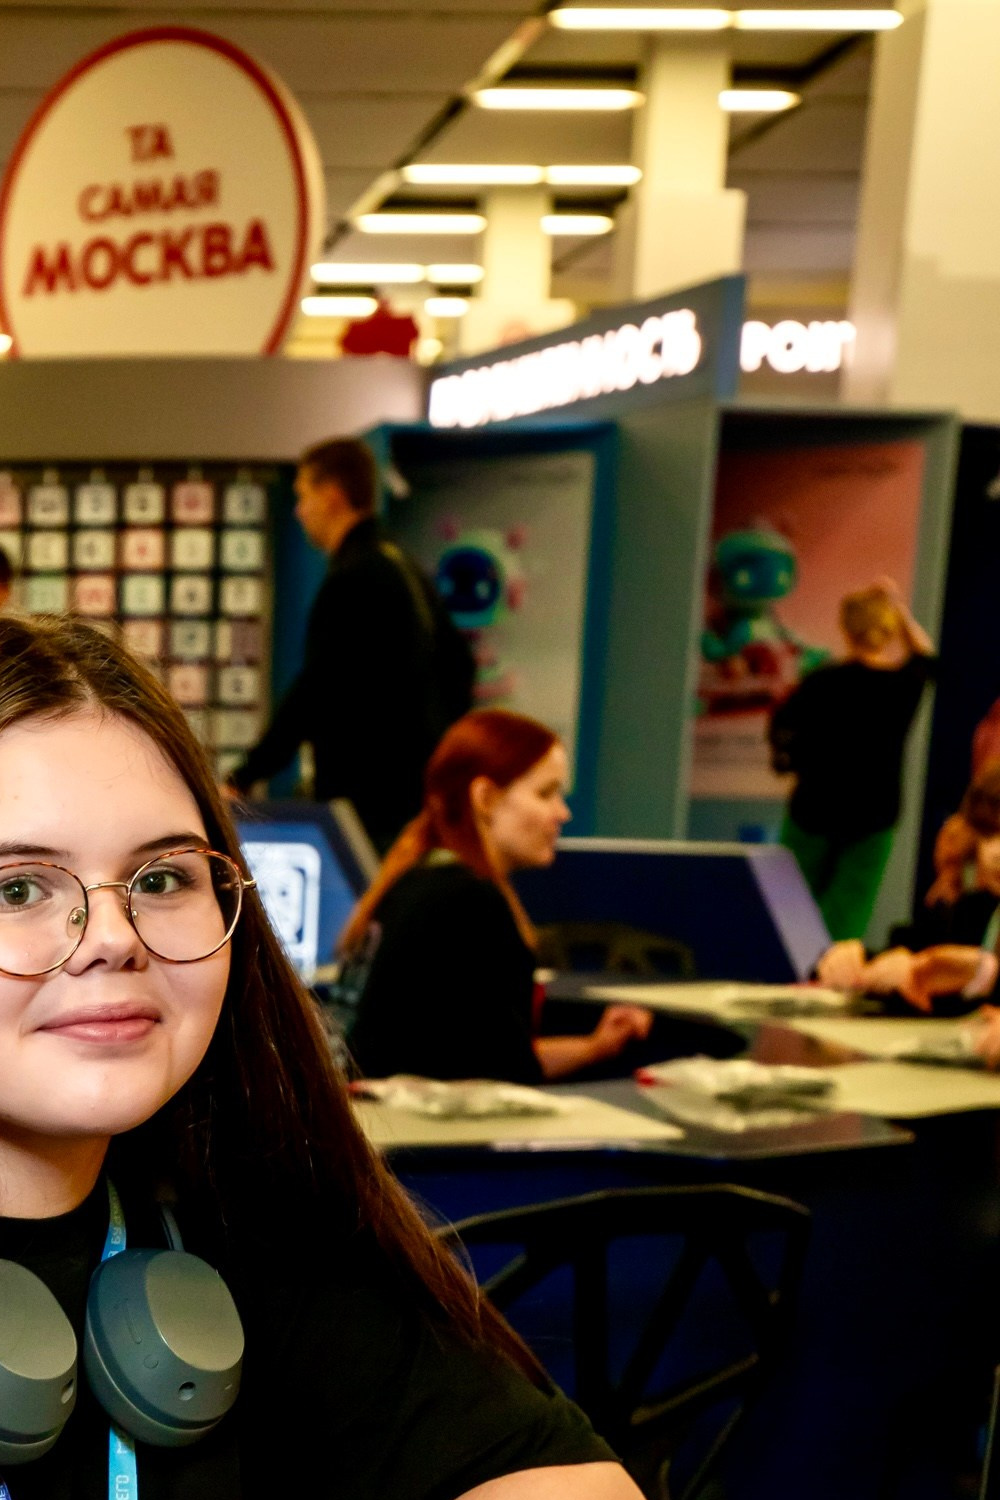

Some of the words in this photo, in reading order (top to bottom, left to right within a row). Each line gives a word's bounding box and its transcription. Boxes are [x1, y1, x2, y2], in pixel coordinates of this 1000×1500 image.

[126, 122, 175, 163] ТА
[77, 168, 221, 224] САМАЯ
[22, 216, 275, 299] МОСКВА
